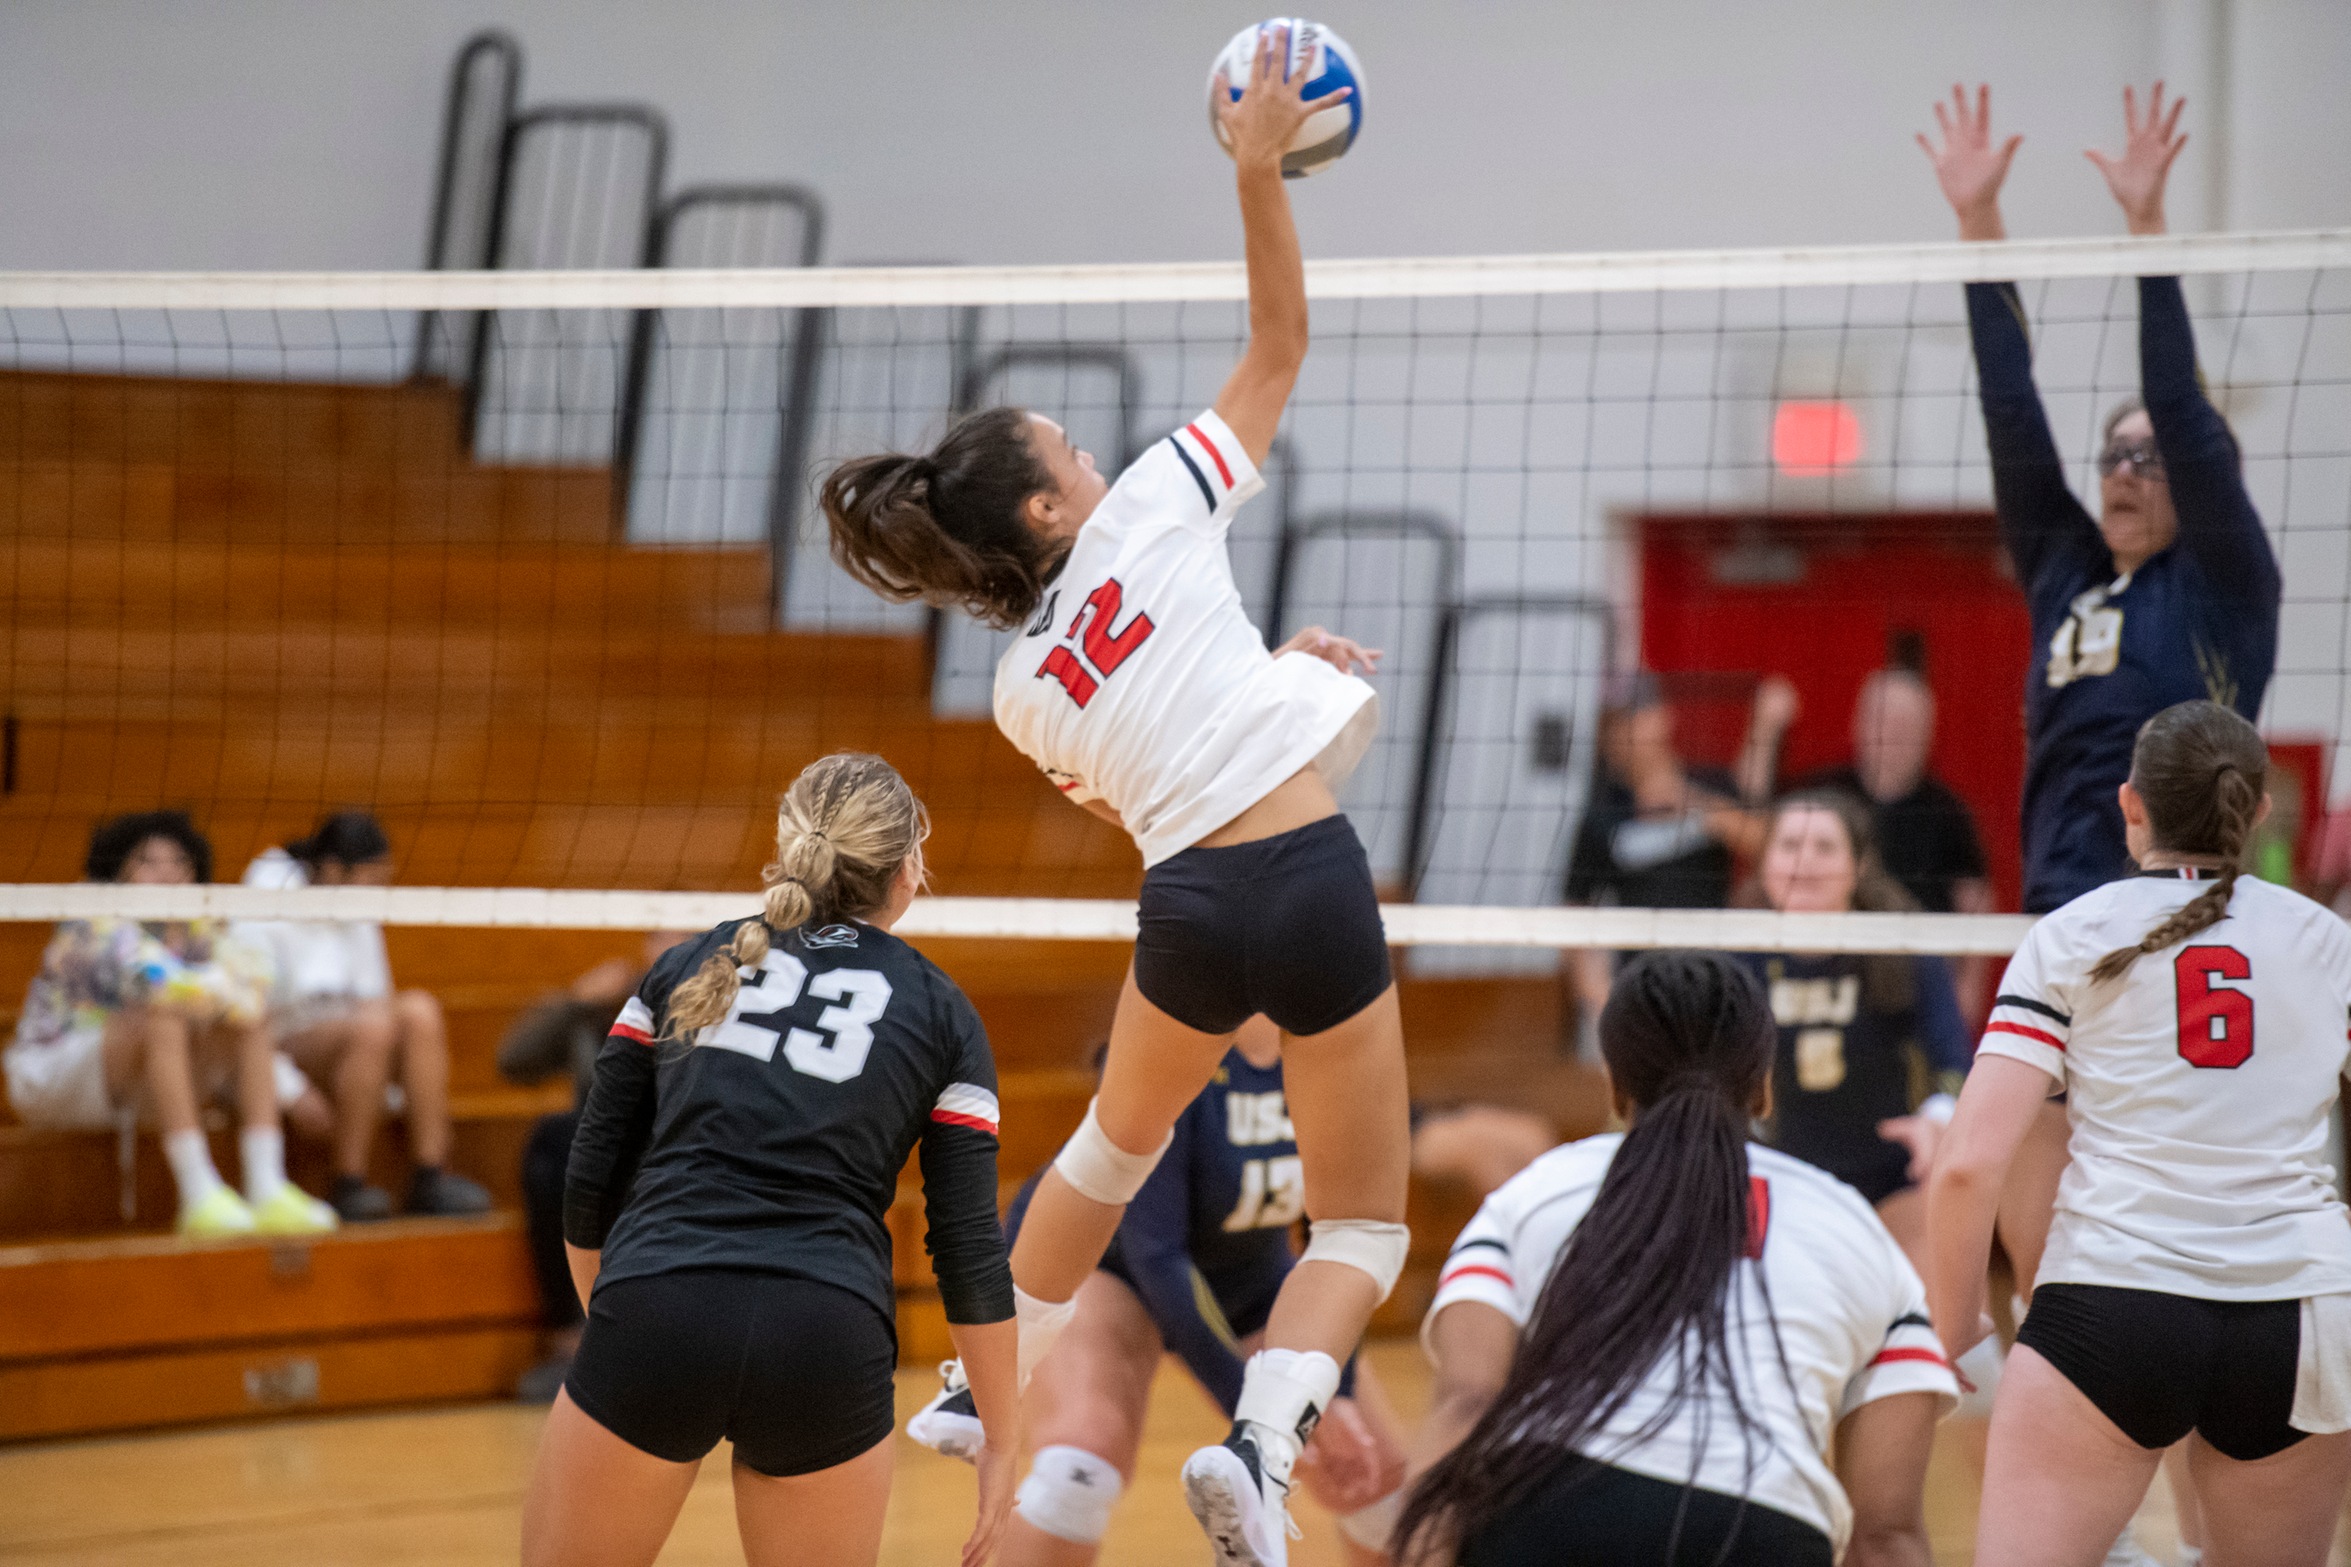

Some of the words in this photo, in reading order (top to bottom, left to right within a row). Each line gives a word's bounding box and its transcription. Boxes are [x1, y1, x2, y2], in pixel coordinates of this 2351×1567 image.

[1035, 577, 1155, 710] 12
[696, 949, 893, 1083] 23
[2174, 945, 2254, 1069] 6
